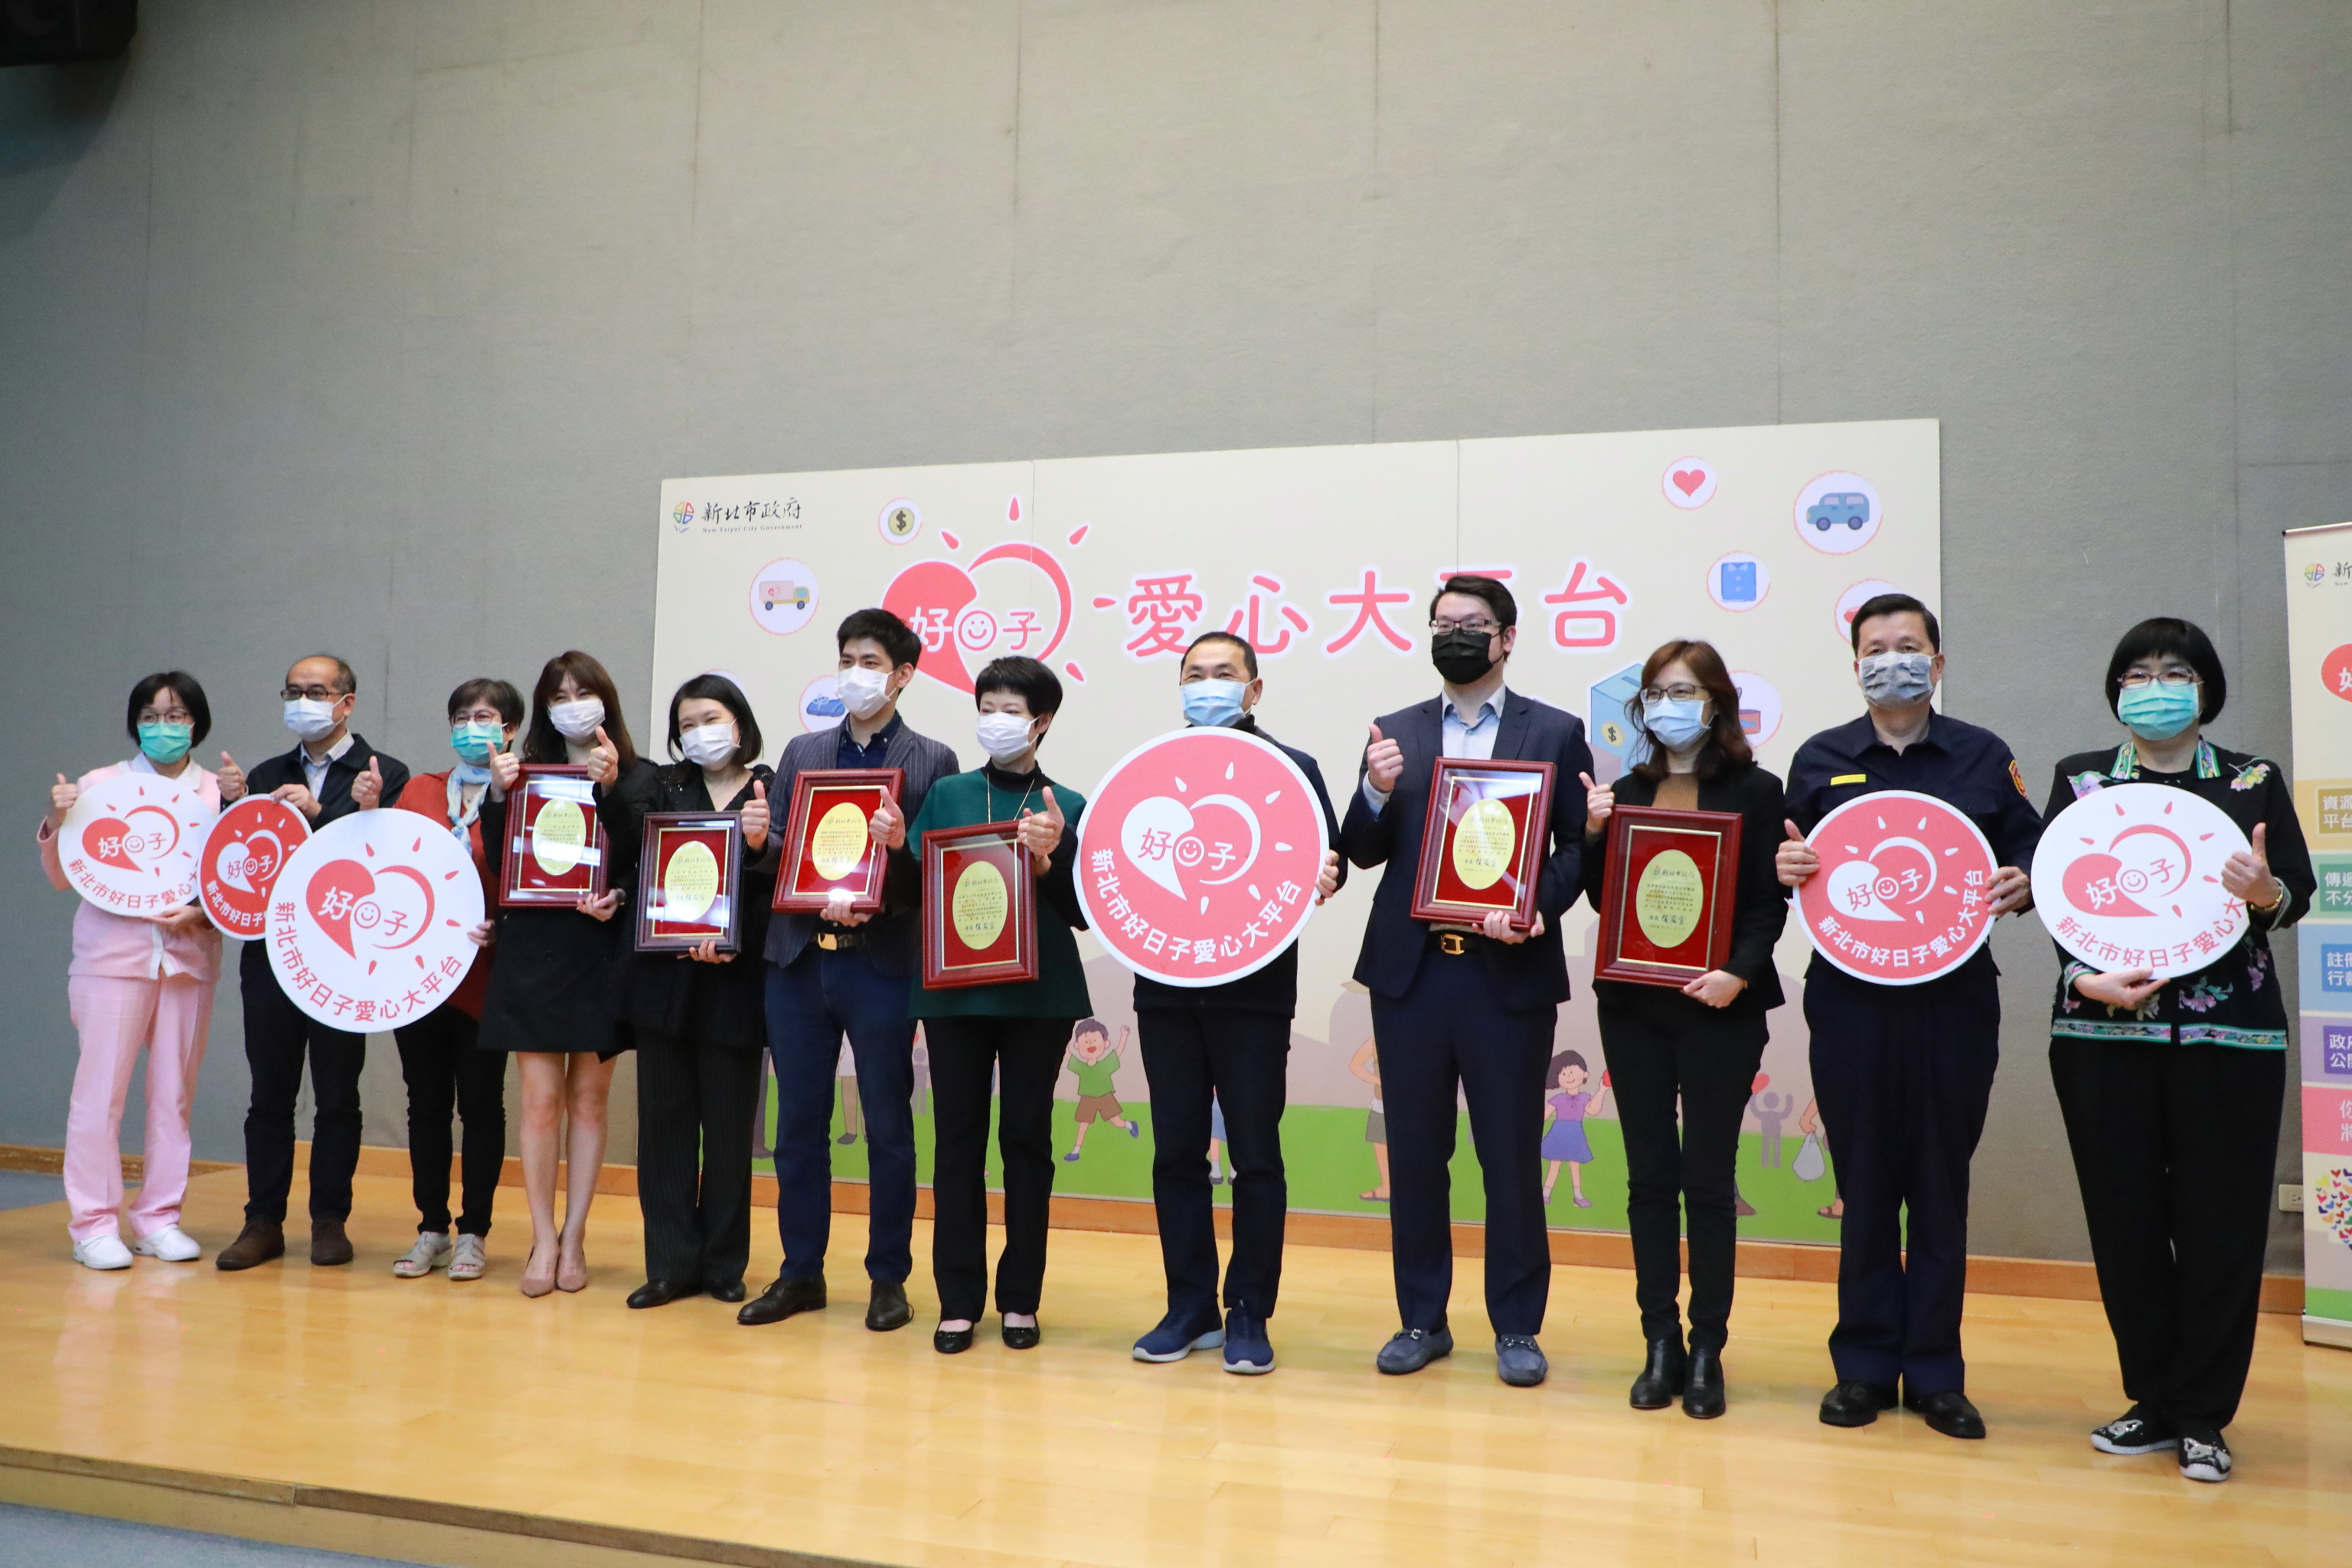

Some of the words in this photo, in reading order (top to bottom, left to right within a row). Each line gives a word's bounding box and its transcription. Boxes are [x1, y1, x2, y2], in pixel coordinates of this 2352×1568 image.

[701, 497, 801, 524] 新北市政府
[1126, 561, 1628, 657] 愛心大台
[205, 879, 267, 927] 新北市好日子
[1091, 848, 1302, 965] 新北市好日子愛心大平台
[1818, 869, 1984, 968] 新北市好日子愛心大平台
[2056, 891, 2247, 968] 新北市好日子愛心大
[274, 901, 463, 1023] 新北市好日子愛心大平台
